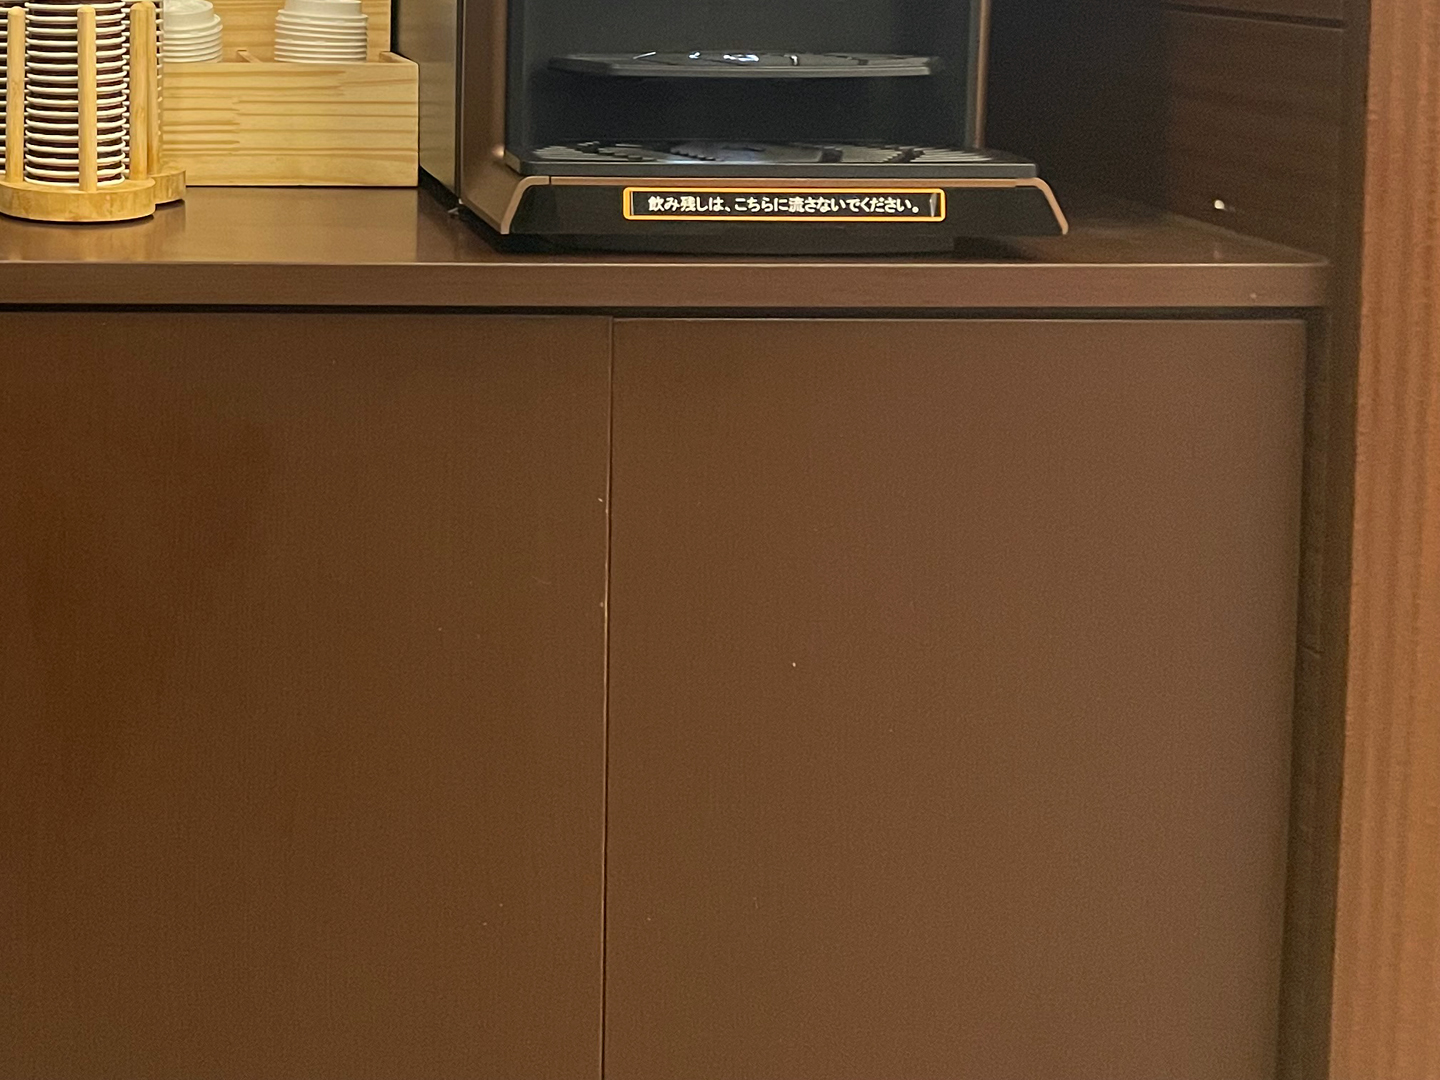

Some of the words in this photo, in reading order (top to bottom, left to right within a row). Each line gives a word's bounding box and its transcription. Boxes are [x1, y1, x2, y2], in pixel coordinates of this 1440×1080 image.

[648, 196, 919, 214] 飲み残しは、こちらに流さないでください。
